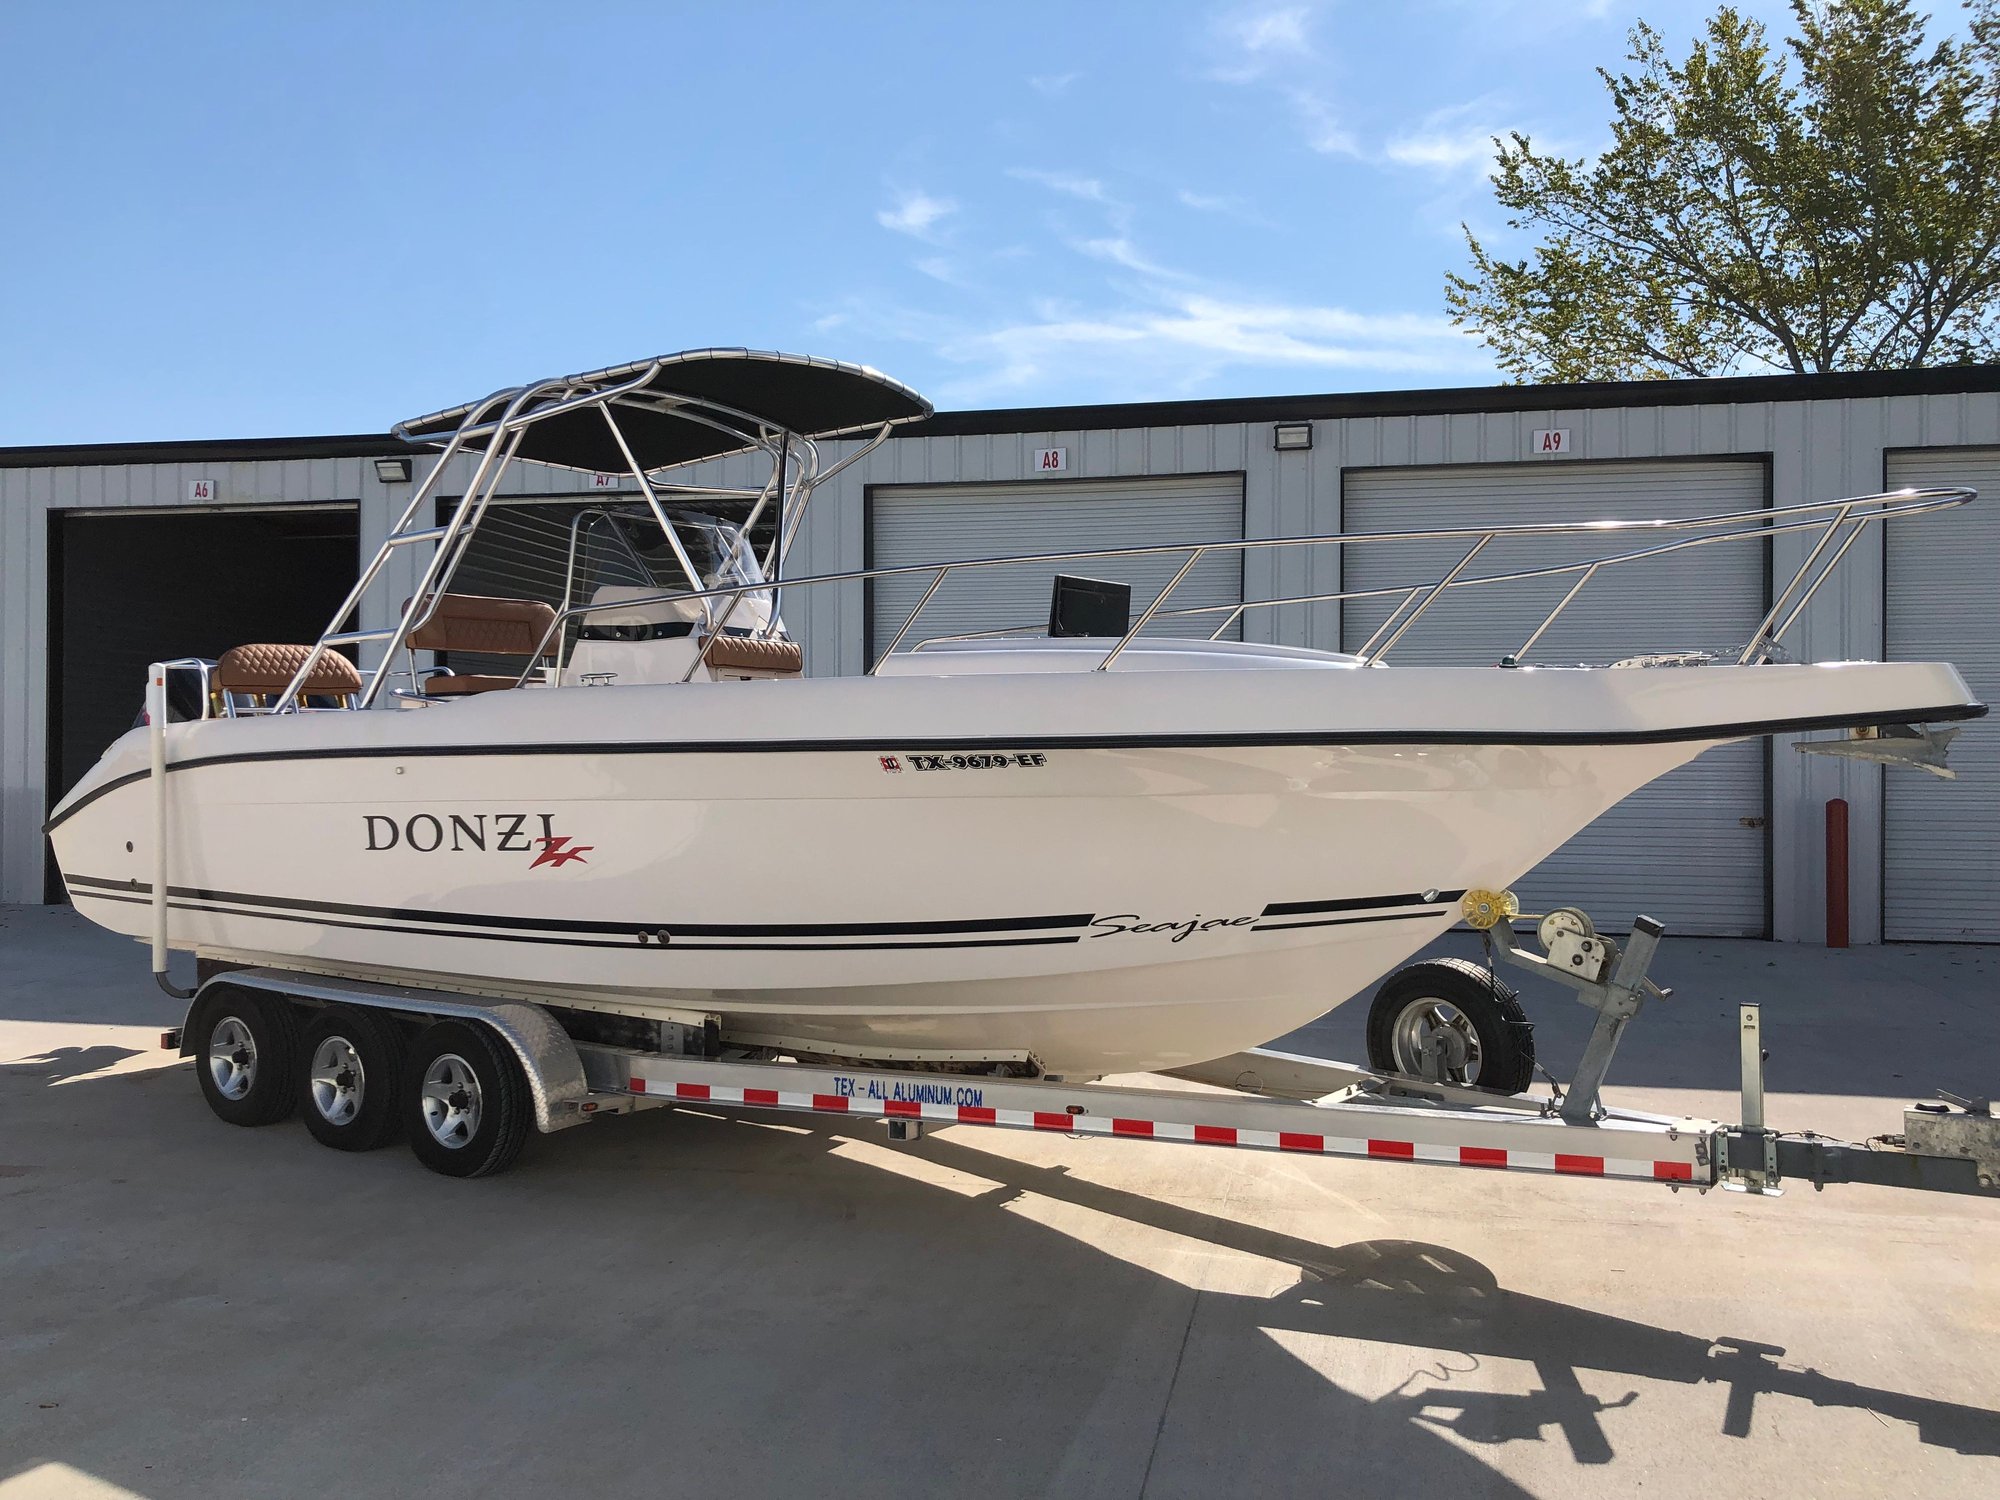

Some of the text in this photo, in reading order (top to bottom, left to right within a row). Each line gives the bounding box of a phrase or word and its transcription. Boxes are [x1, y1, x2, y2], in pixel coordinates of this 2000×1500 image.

[1543, 432, 1561, 451] A9
[1043, 451, 1059, 469] A8
[194, 482, 208, 498] A6
[906, 753, 1047, 771] TX-9679-EF
[363, 813, 559, 852] DONZI
[1090, 912, 1260, 943] Seajae
[834, 1077, 855, 1097] TEX
[868, 1079, 889, 1100] ALL
[893, 1081, 983, 1107] ALUMINUM.COM
